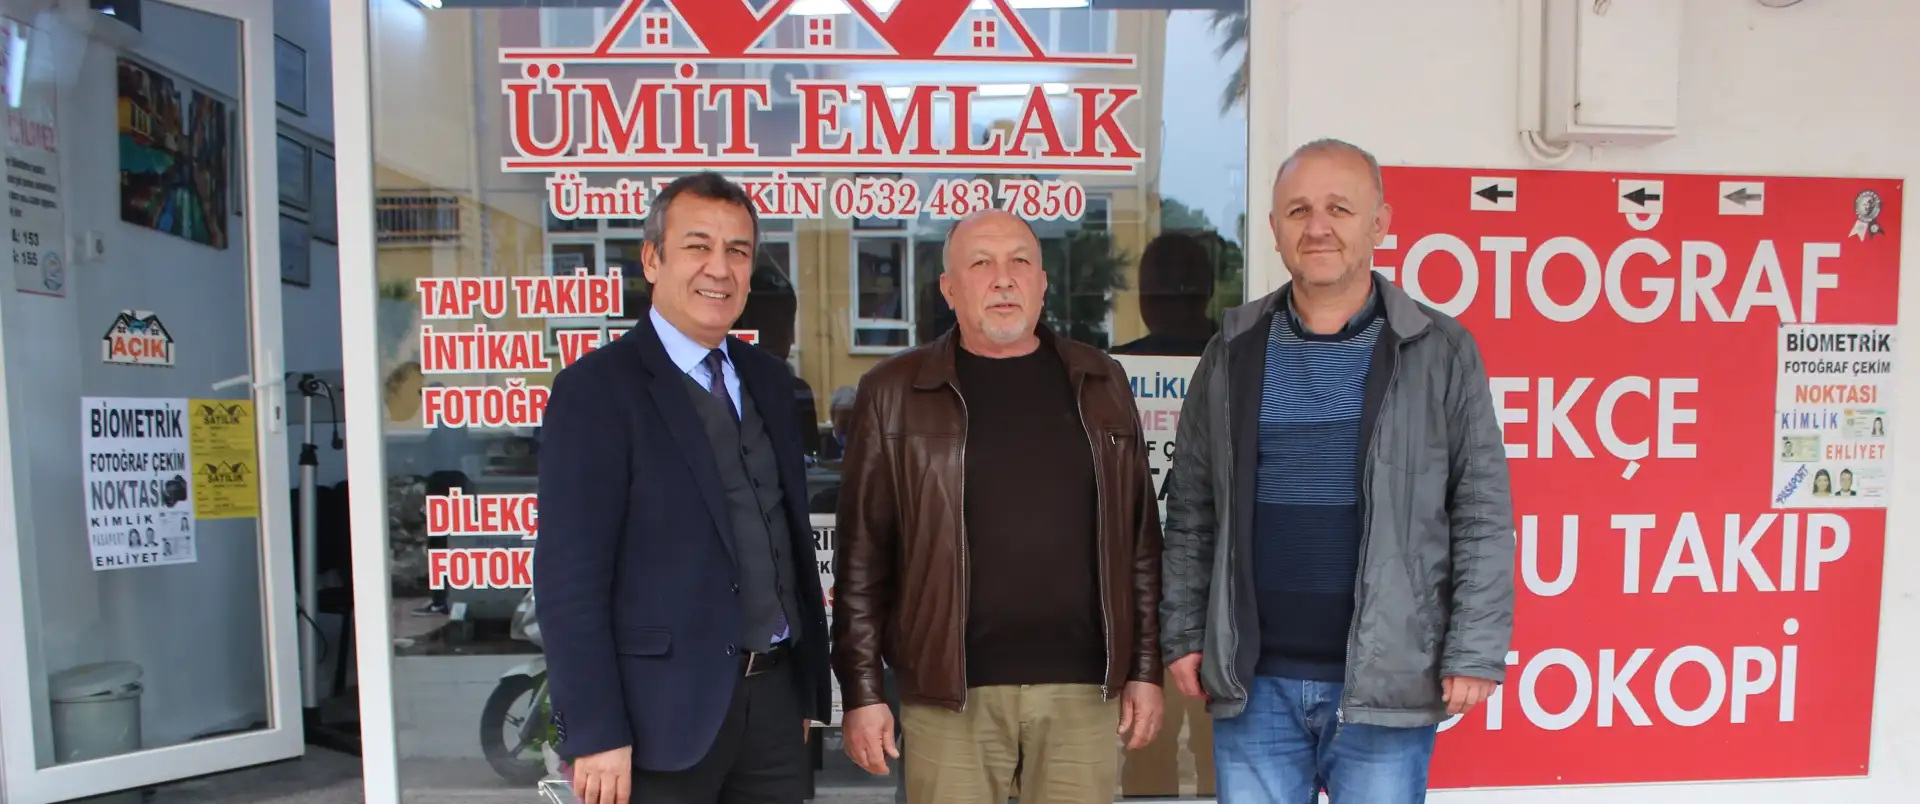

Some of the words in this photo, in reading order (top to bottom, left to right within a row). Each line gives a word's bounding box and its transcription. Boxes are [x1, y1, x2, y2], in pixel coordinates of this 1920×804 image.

[508, 63, 768, 157] ÜMİT
[798, 84, 1141, 158] EMLAK
[552, 173, 646, 216] Ümit
[834, 182, 918, 216] 0532
[930, 182, 990, 215] 483
[1003, 182, 1083, 217] 7850
[419, 280, 504, 316] TAPU
[515, 270, 621, 314] TAKİBİ
[112, 336, 166, 363] AÇIK
[422, 326, 549, 371] İNTİKAL
[1786, 329, 1891, 352] BİOMETRİK
[1784, 359, 1848, 374] FOTOĞRAF
[1852, 360, 1891, 377] ÇEKİM
[425, 380, 549, 425] FOTOĞR
[1795, 384, 1877, 404] NOKTASI
[90, 401, 184, 439] BİOMETRİK
[1489, 375, 1699, 480] EKÇE
[1781, 408, 1838, 430] KİMLİK
[90, 450, 149, 473] FOTOĞRAF
[152, 448, 186, 476] ÇEKİM
[1825, 441, 1885, 460] EHLİYET
[91, 513, 154, 528] KİMLİK
[430, 490, 538, 537] DİLEKÇ
[95, 552, 159, 567] EHLİYET
[431, 551, 533, 587] FOTOK
[1436, 618, 1799, 732] TOKOPİ
